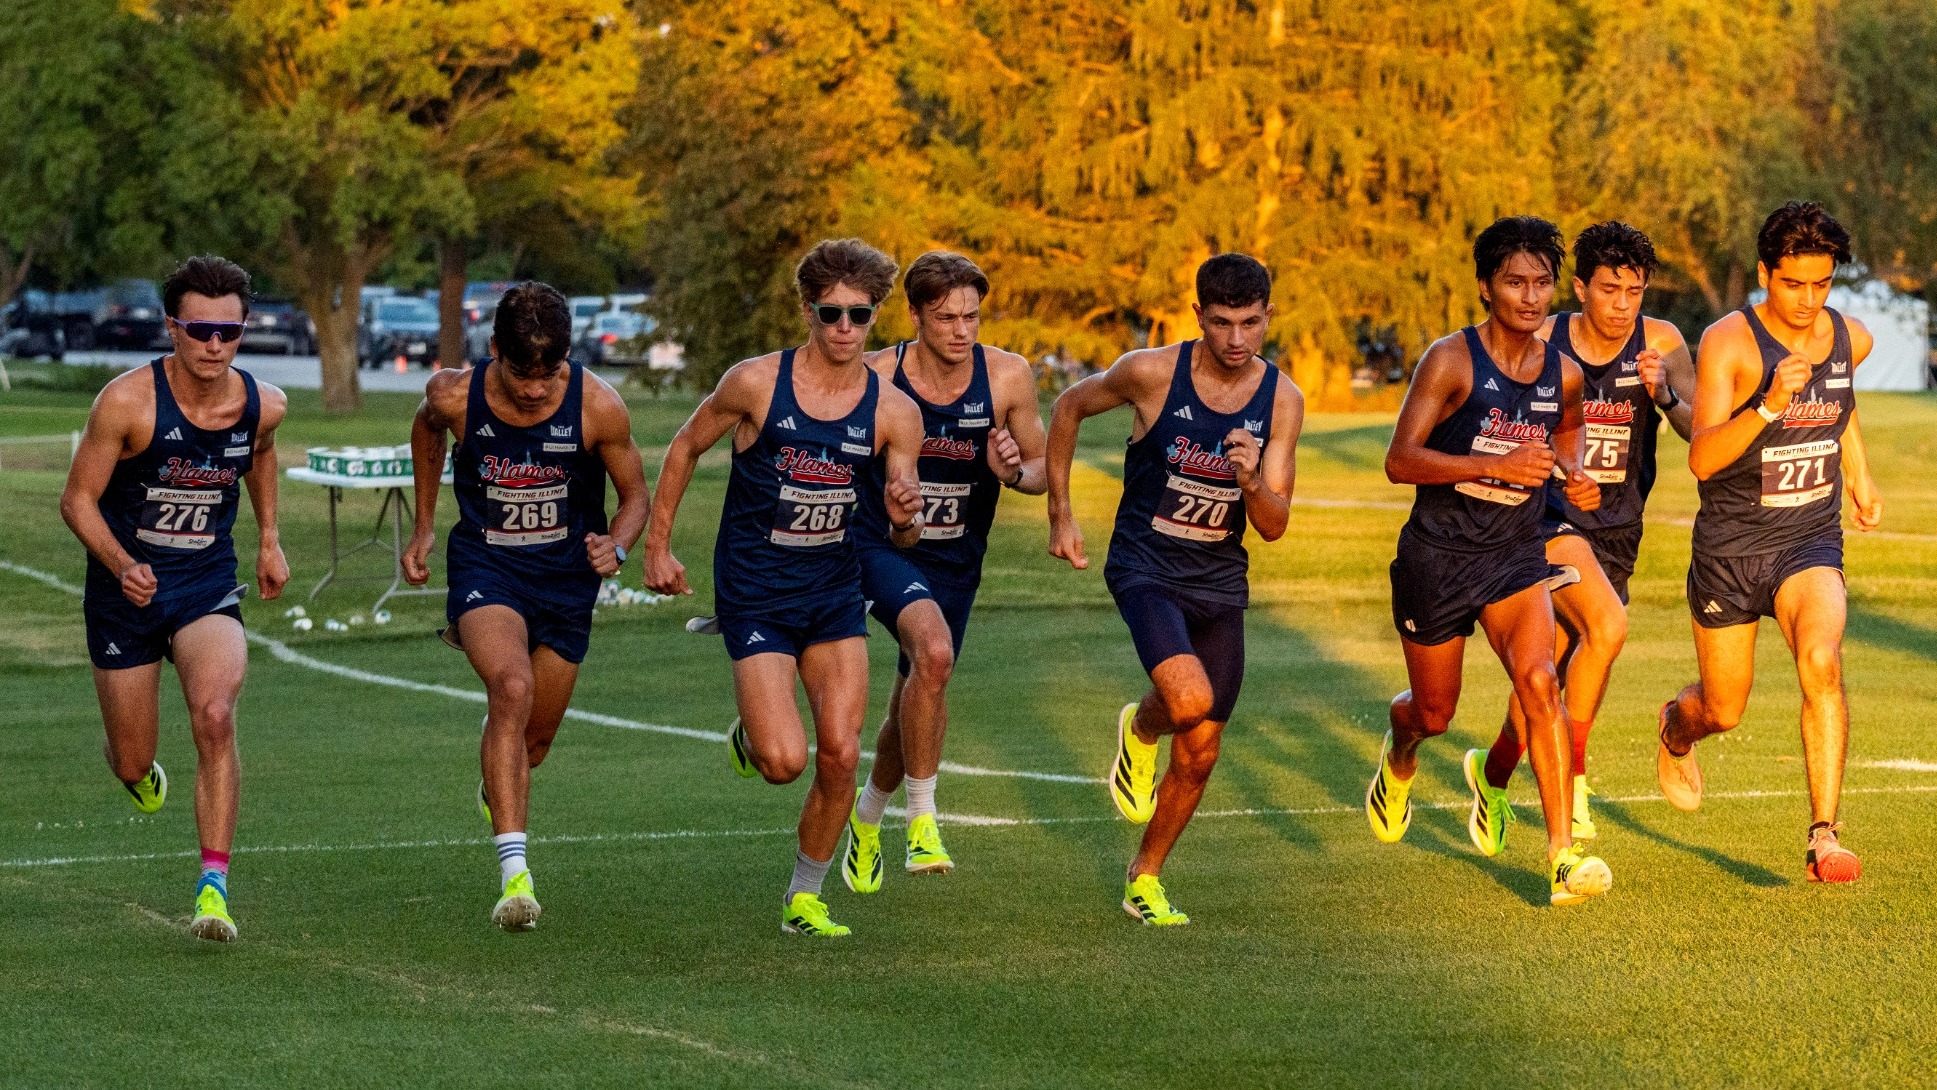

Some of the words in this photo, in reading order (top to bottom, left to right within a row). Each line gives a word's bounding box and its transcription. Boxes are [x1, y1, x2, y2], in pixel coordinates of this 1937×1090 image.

[1583, 400, 1633, 419] ames
[550, 424, 573, 437] VALLEY
[1481, 407, 1546, 441] Flames
[920, 437, 975, 457] ames
[1168, 436, 1237, 474] Flam
[1583, 440, 1619, 468] 75
[1772, 446, 1810, 457] FIGHTING
[159, 456, 236, 486] Flames
[481, 454, 566, 483] Flames
[776, 446, 853, 481] Flames
[1778, 457, 1826, 491] 271
[158, 491, 197, 499] FIGHTING
[497, 490, 537, 498] FIGHTING
[791, 490, 829, 500] FIGHTING
[1178, 481, 1218, 495] FIGHTING
[155, 503, 210, 532] 276
[502, 501, 557, 530] 269
[790, 504, 844, 531] 268
[925, 497, 959, 524] 73
[1172, 495, 1229, 527] 270
